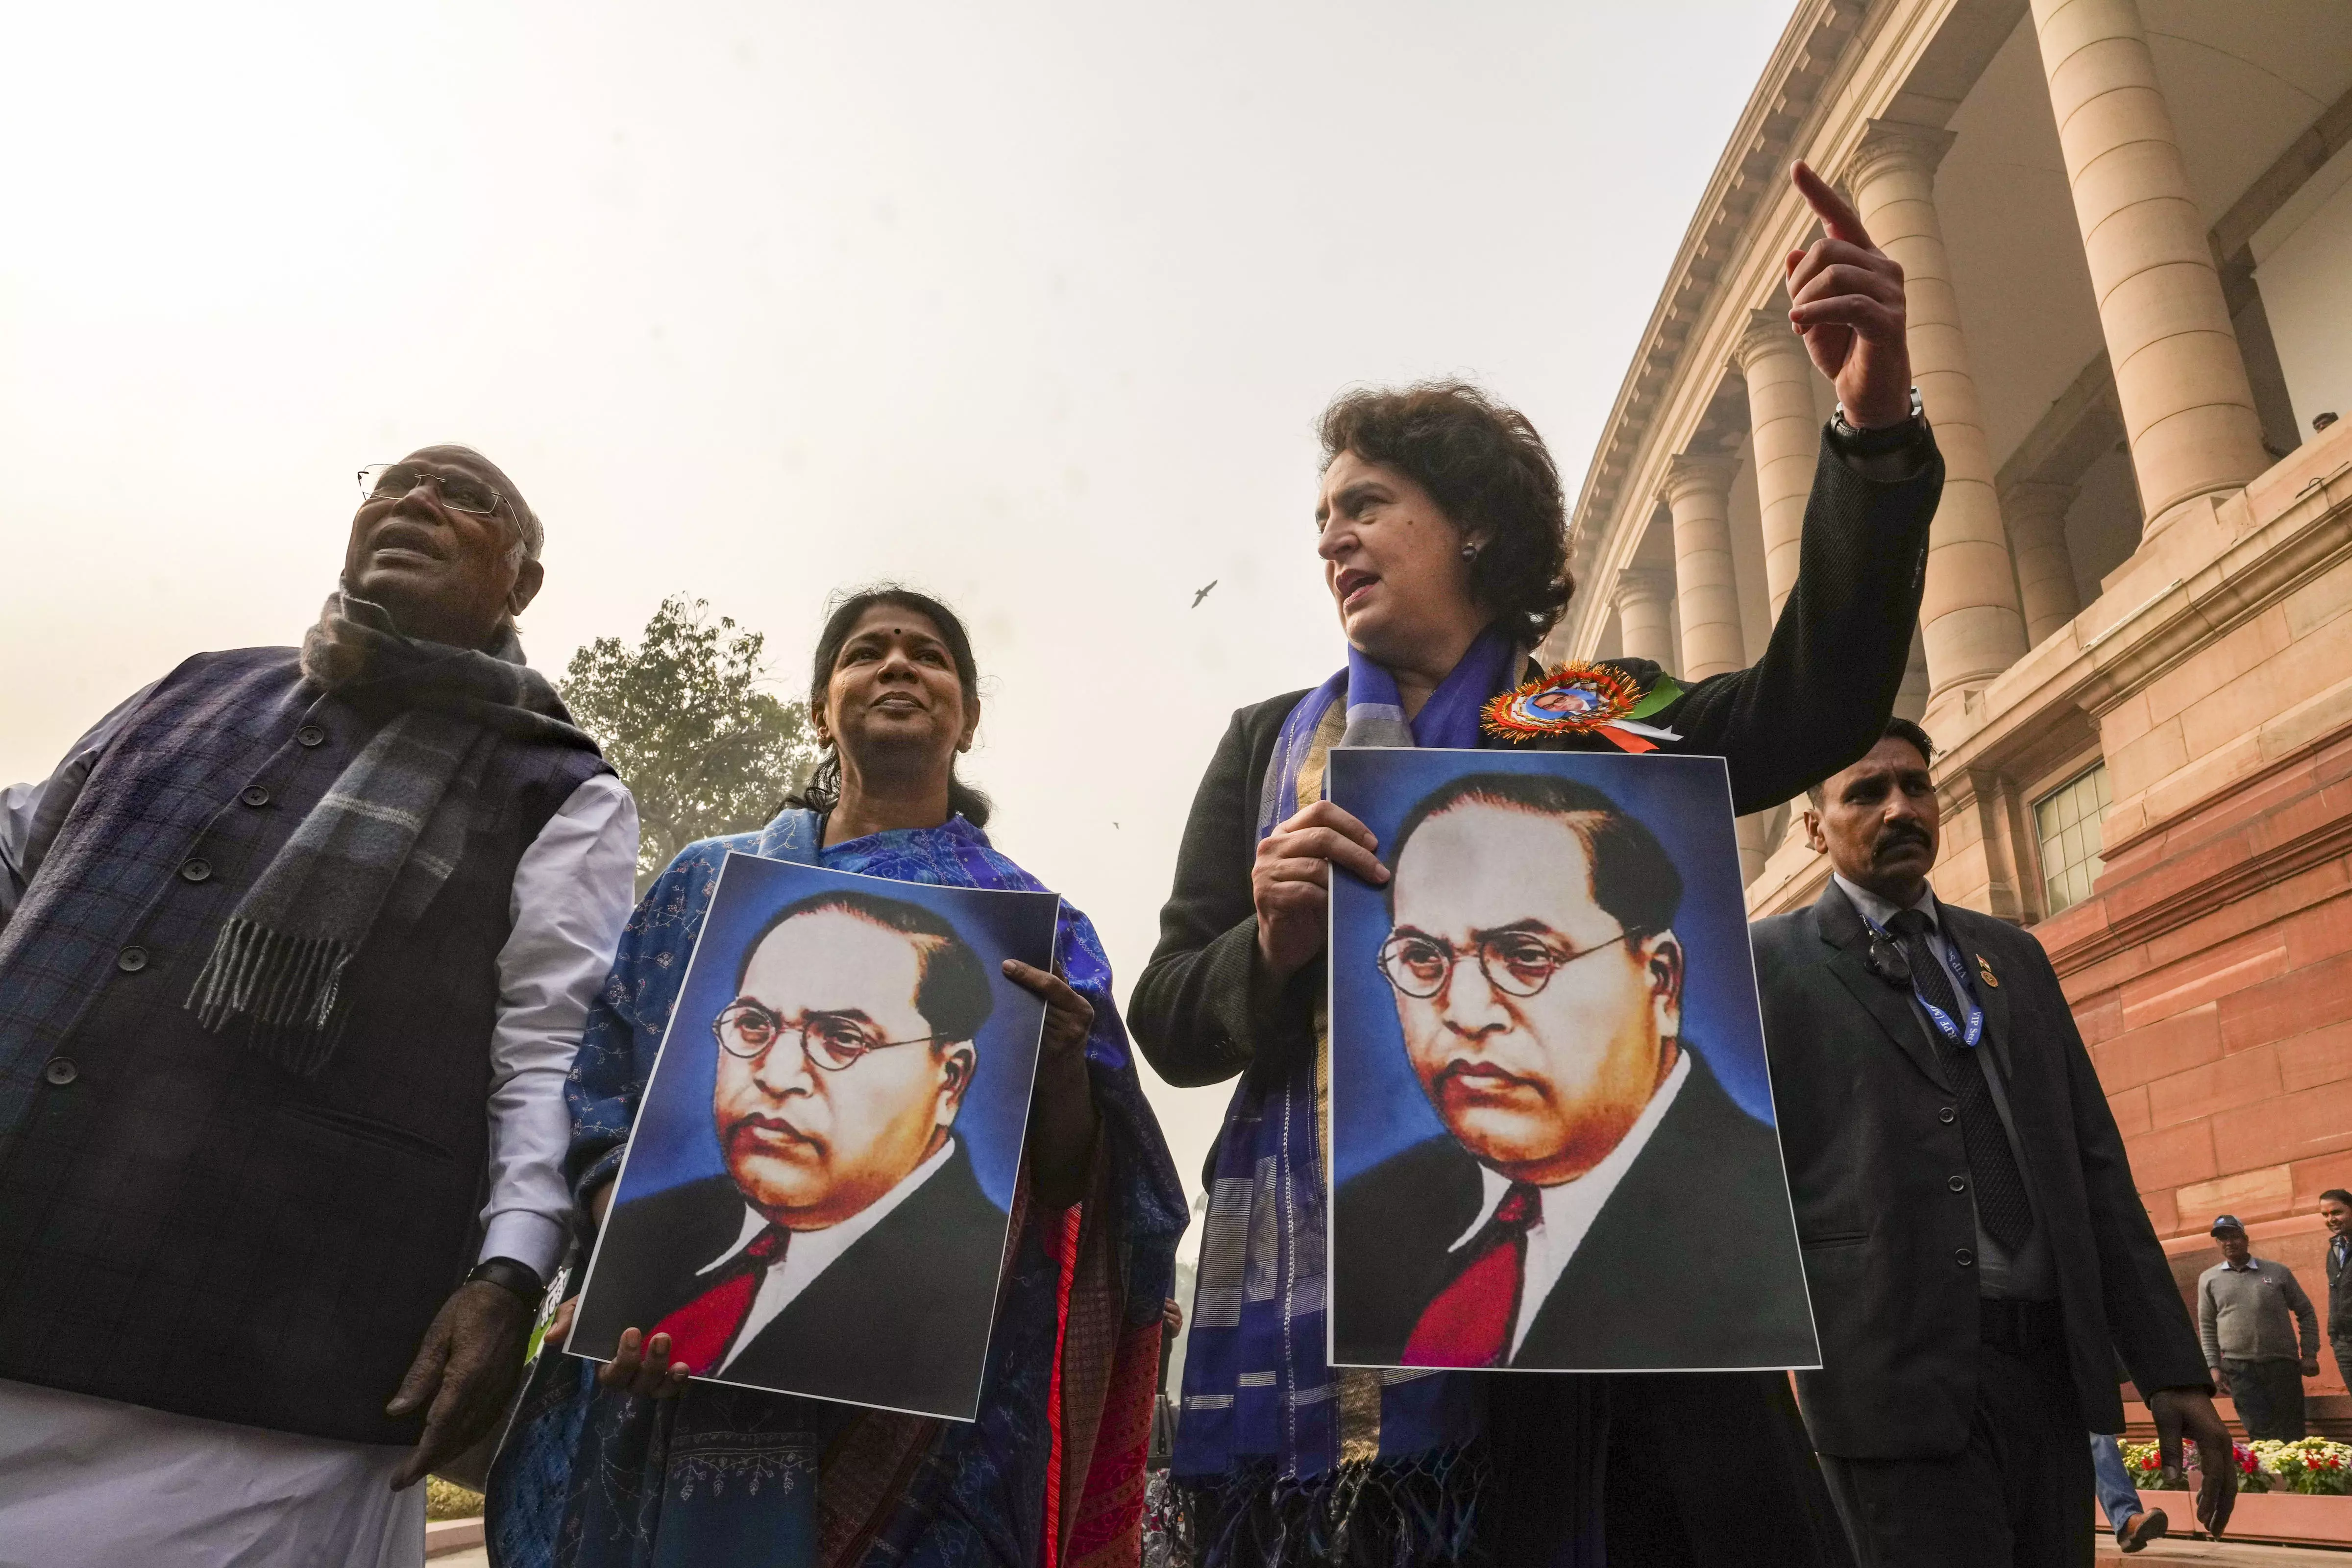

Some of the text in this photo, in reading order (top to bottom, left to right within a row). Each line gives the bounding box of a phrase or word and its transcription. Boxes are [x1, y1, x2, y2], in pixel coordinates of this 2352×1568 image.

[1952, 961, 1966, 979] VIP
[1971, 1011, 1981, 1026] VIP
[1940, 1021, 1960, 1045] CRPF
